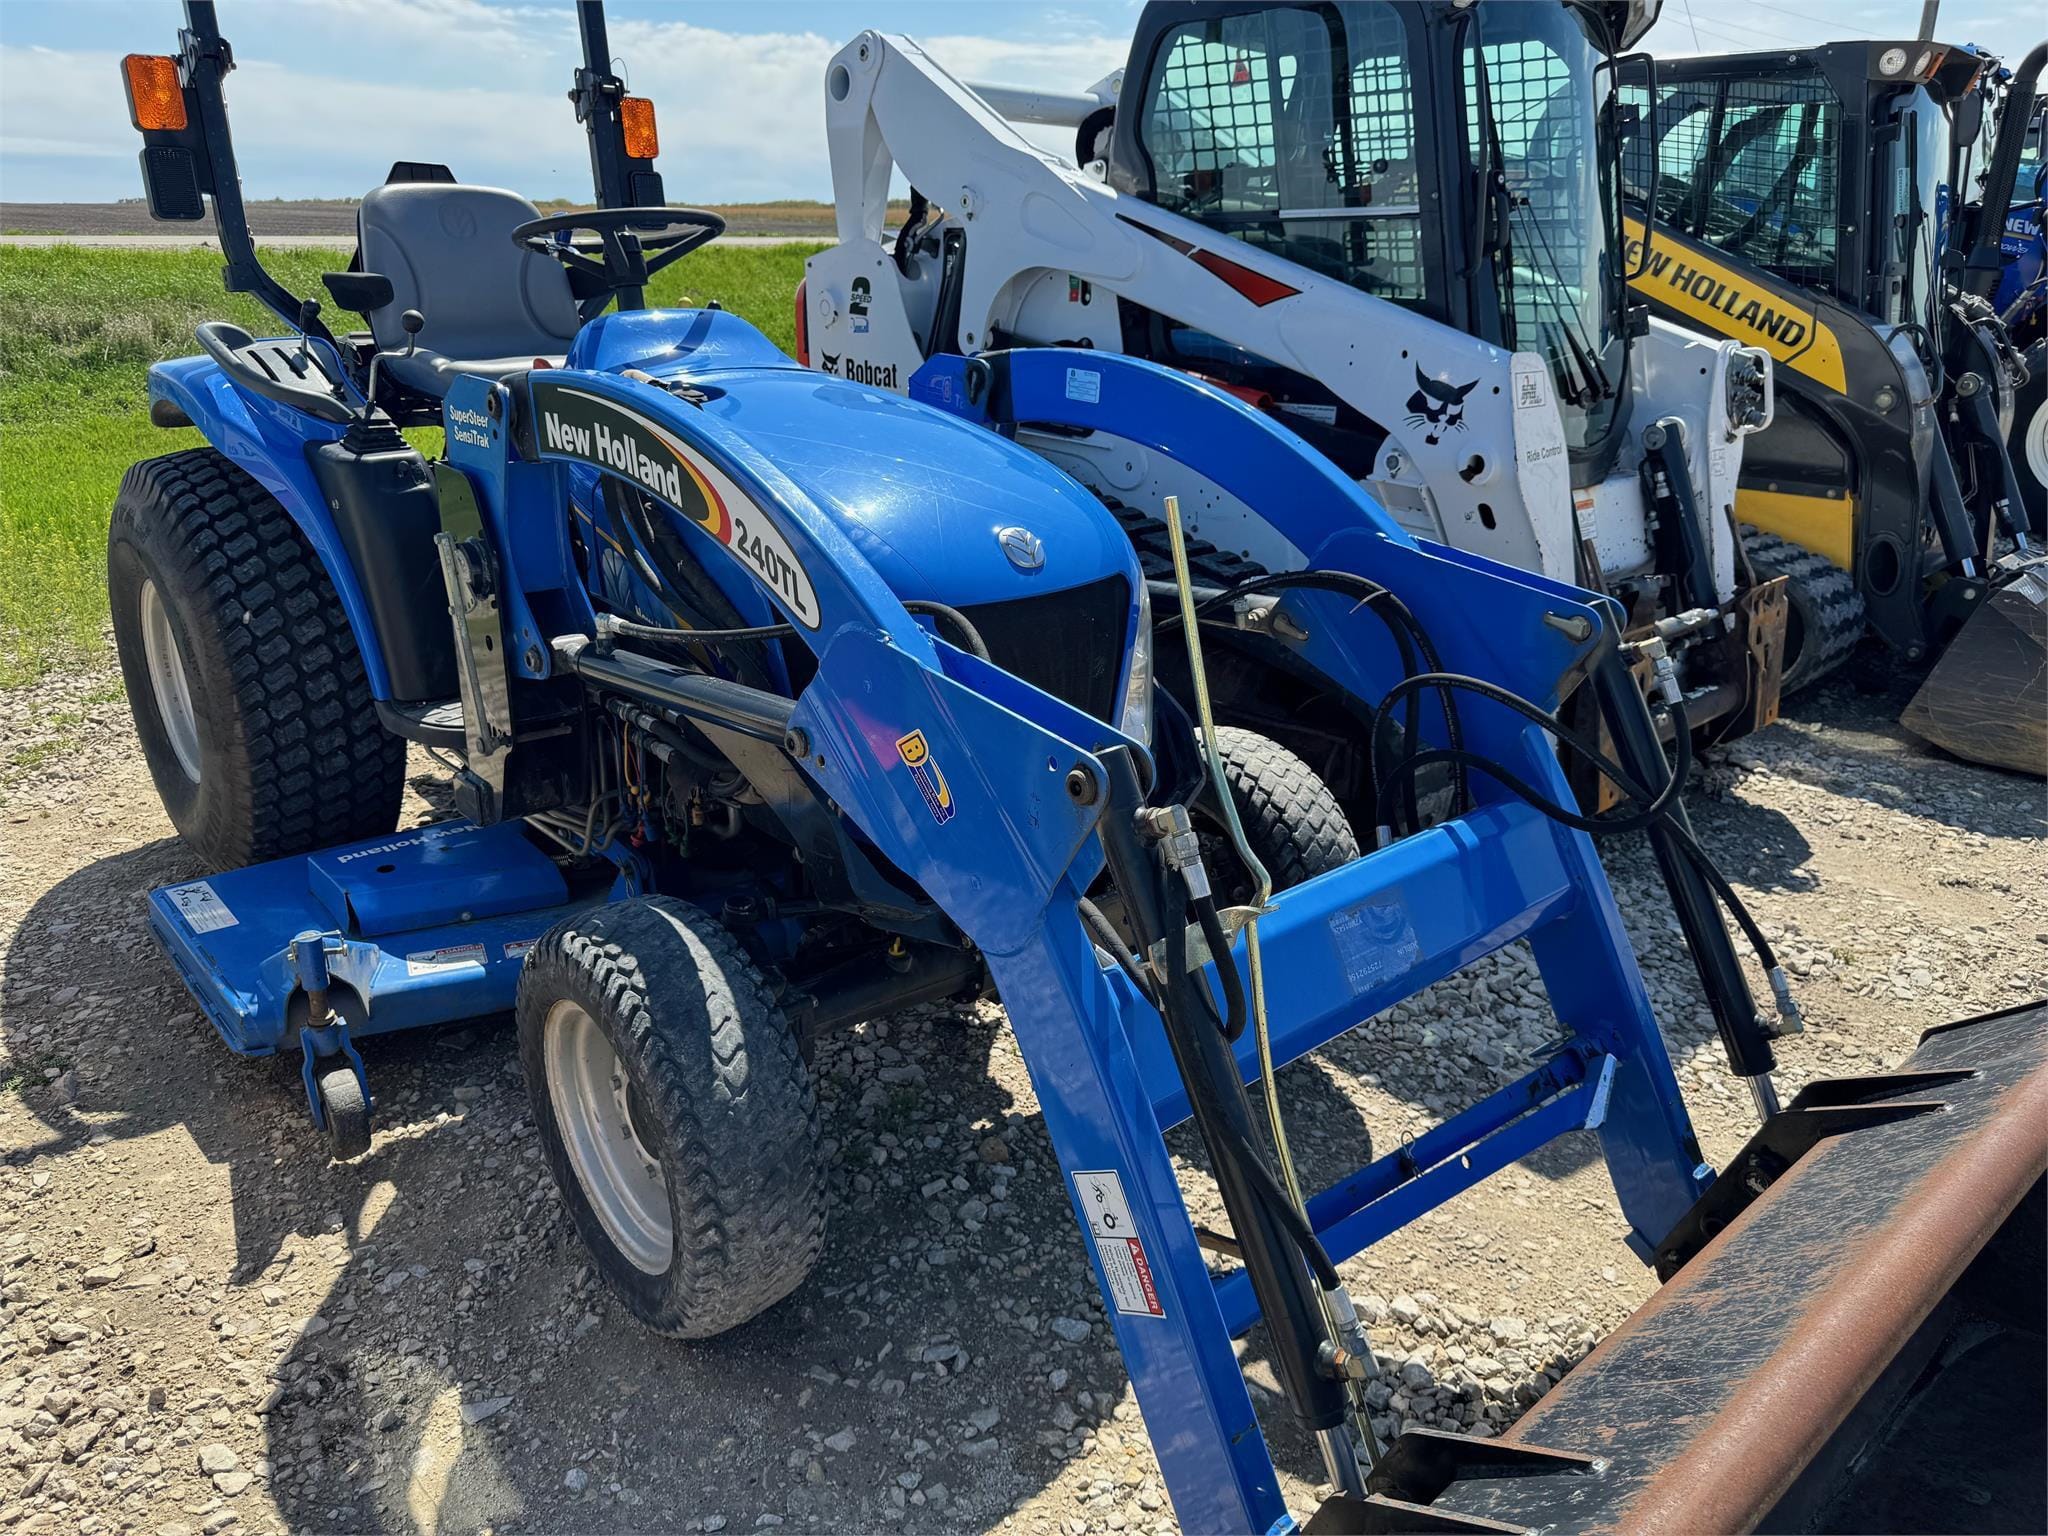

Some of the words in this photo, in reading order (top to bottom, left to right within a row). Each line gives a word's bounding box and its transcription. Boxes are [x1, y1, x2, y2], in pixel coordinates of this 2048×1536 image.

[2005, 217, 2041, 236] NEW
[850, 292, 873, 304] SPEED
[1625, 234, 1673, 278] EW
[1668, 262, 1806, 348] HOLLAND
[845, 358, 898, 389] Bobcat
[449, 404, 489, 428] SuperSteer
[453, 426, 490, 449] SensiTrak
[544, 411, 590, 457] New
[594, 422, 683, 508] Holland
[1526, 449, 1541, 464] Ride
[1541, 444, 1563, 459] Control
[735, 517, 808, 617] 240TL
[431, 823, 484, 840] New
[336, 835, 432, 864] Holland
[1135, 1257, 1159, 1310] DANGER
